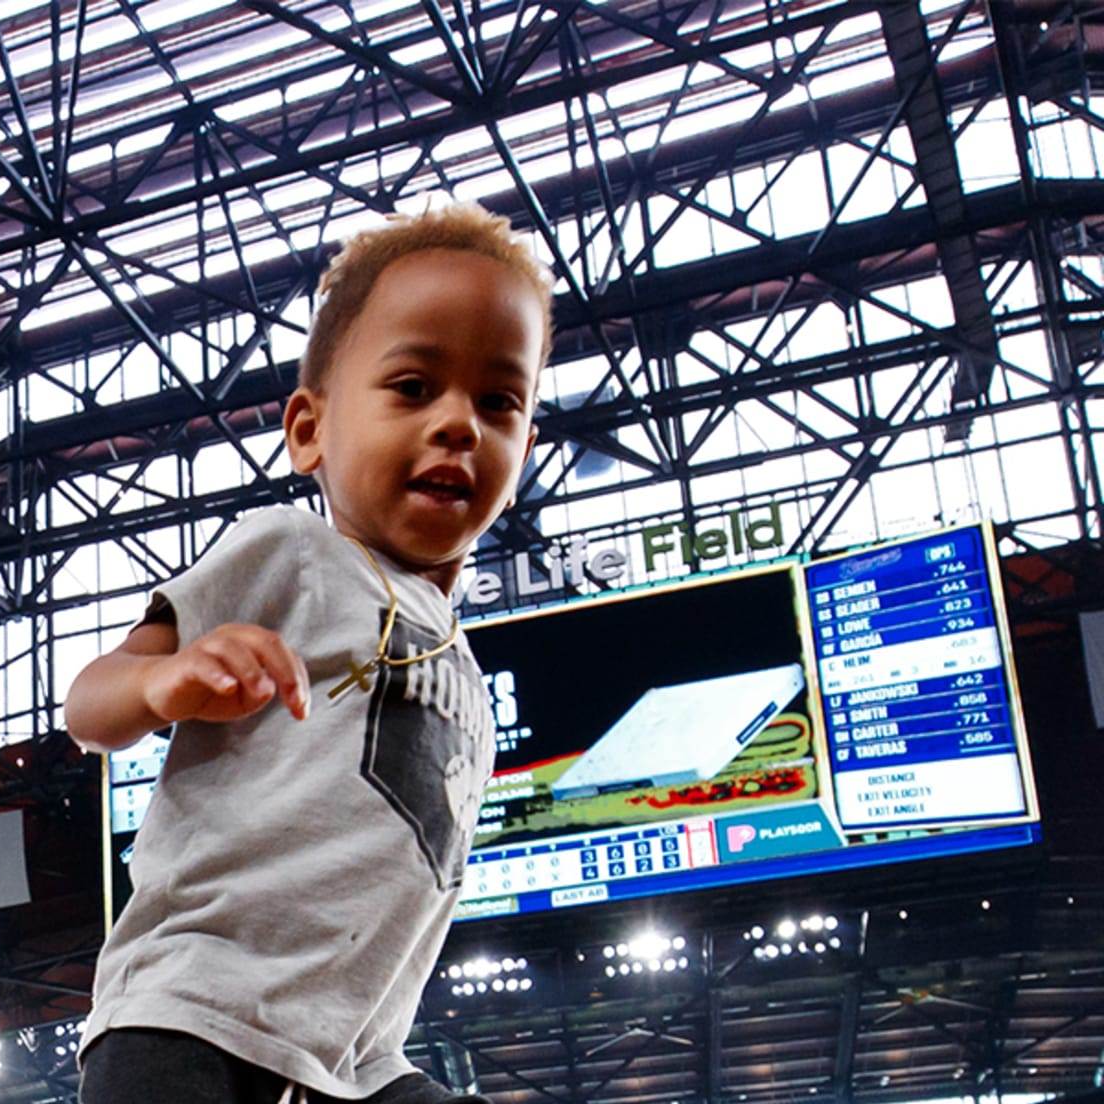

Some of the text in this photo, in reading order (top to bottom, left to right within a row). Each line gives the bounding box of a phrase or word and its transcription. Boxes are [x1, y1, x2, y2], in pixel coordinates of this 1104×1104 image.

[515, 537, 627, 596] Life
[643, 502, 784, 573] Field
[838, 618, 872, 636] LOWE
[850, 706, 888, 723] SMITH
[852, 722, 899, 741] CARTER
[956, 712, 990, 727] .771
[893, 802, 925, 816] ANGLE
